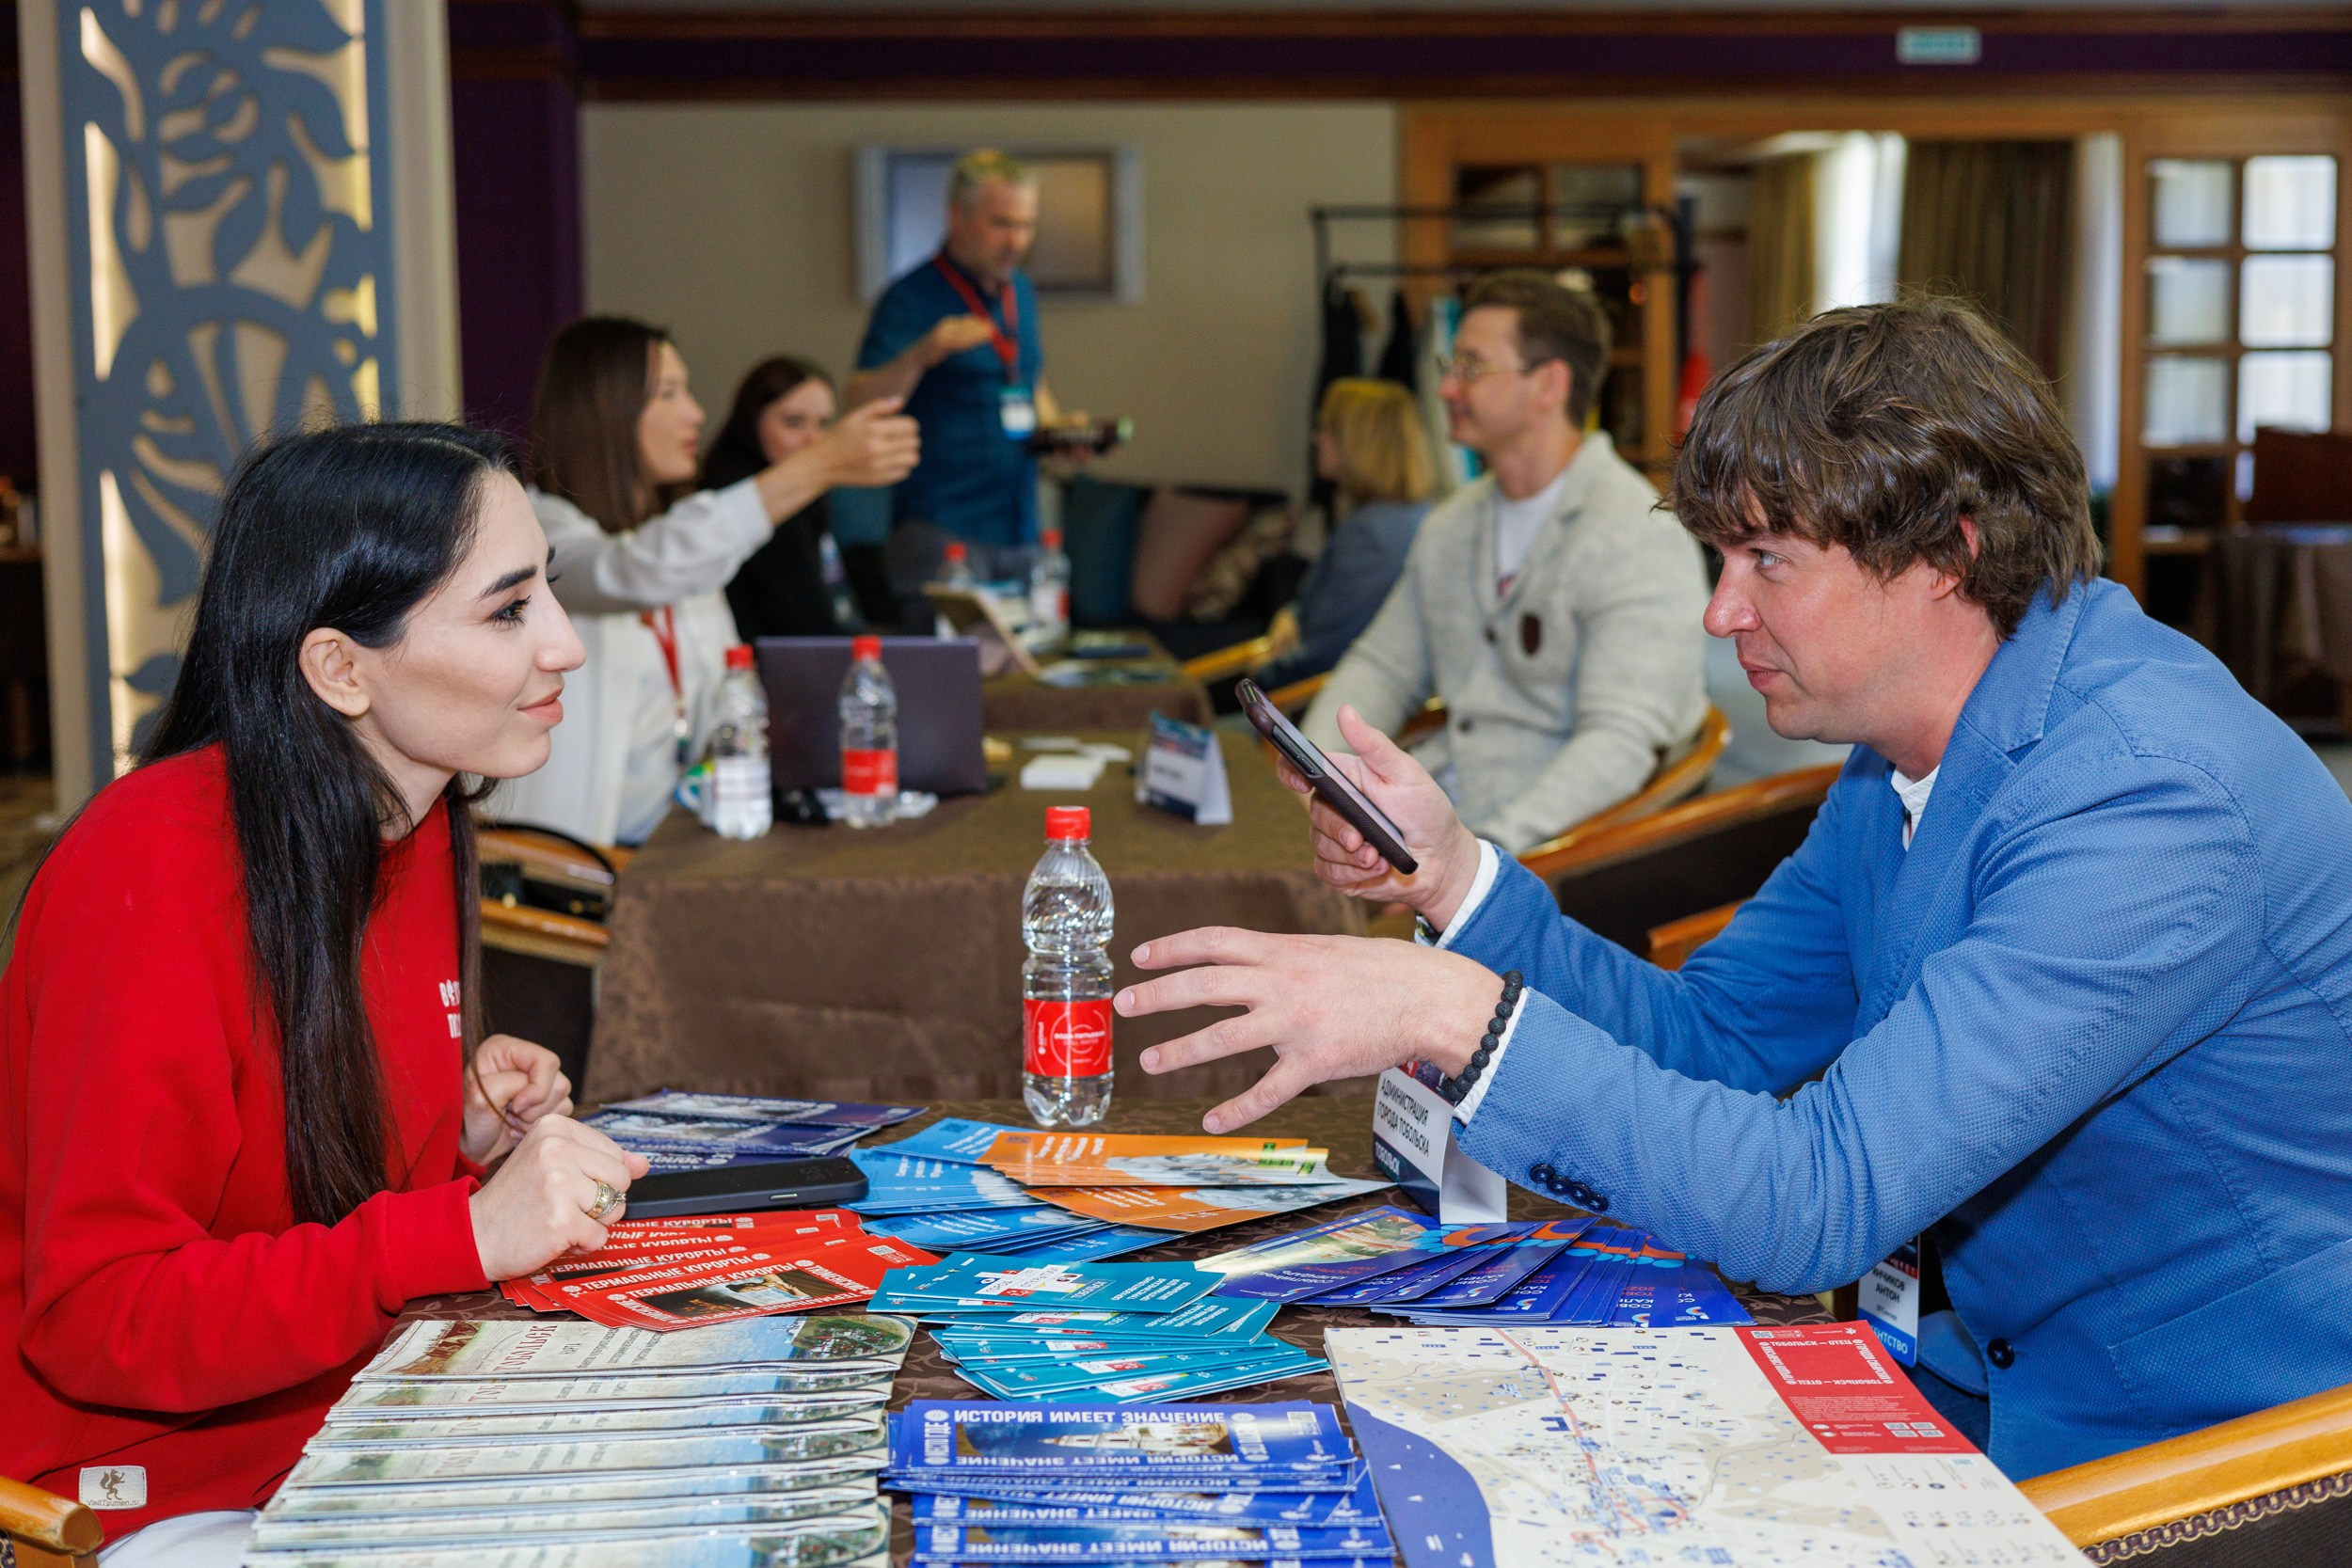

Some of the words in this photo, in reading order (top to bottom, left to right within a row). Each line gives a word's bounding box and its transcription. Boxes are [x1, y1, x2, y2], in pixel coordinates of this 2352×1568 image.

[1381, 1078, 1428, 1127] АДМИНИСТРАЦИЯ
[1377, 1101, 1398, 1129] ГОРОДА
[1399, 1117, 1429, 1157] ТОБОЛЬСКА
[1375, 1142, 1400, 1176] ТОБОЛЬСК
[549, 1256, 654, 1273] ТЕРМАЛЬНЫЕ
[655, 1248, 727, 1261] КУРОРТЫ
[580, 1267, 682, 1291] ТЕРМАЛЬНЫЕ
[683, 1256, 753, 1276] КУРОРТЫ
[626, 1275, 727, 1298] ТЕРМАЛЬНЫЕ
[730, 1262, 798, 1281] КУРОРТЫ
[493, 1324, 558, 1371] ТОБОЛЬСК
[1872, 1325, 1909, 1354] ЕНТСТВО
[954, 1410, 1043, 1423] ИСТОРИЯ
[1049, 1411, 1116, 1423] ИМЕЕТ
[1121, 1412, 1225, 1423] ЗНАЧЕНИЕ
[956, 1457, 1066, 1466] ЗНАЧЕНИЕ
[1072, 1456, 1140, 1465] ИМЕЕТ
[1147, 1454, 1239, 1465] ИСТОРИЯ
[1117, 1494, 1214, 1512] ИСТОРИЯ
[965, 1508, 1079, 1519] ЗНАЧЕНИЕ
[965, 1542, 1081, 1554] ЗНАЧЕНИЕ
[1089, 1541, 1163, 1553] ИМЕЕТ
[1168, 1540, 1268, 1553] ИСТОРИЯ
